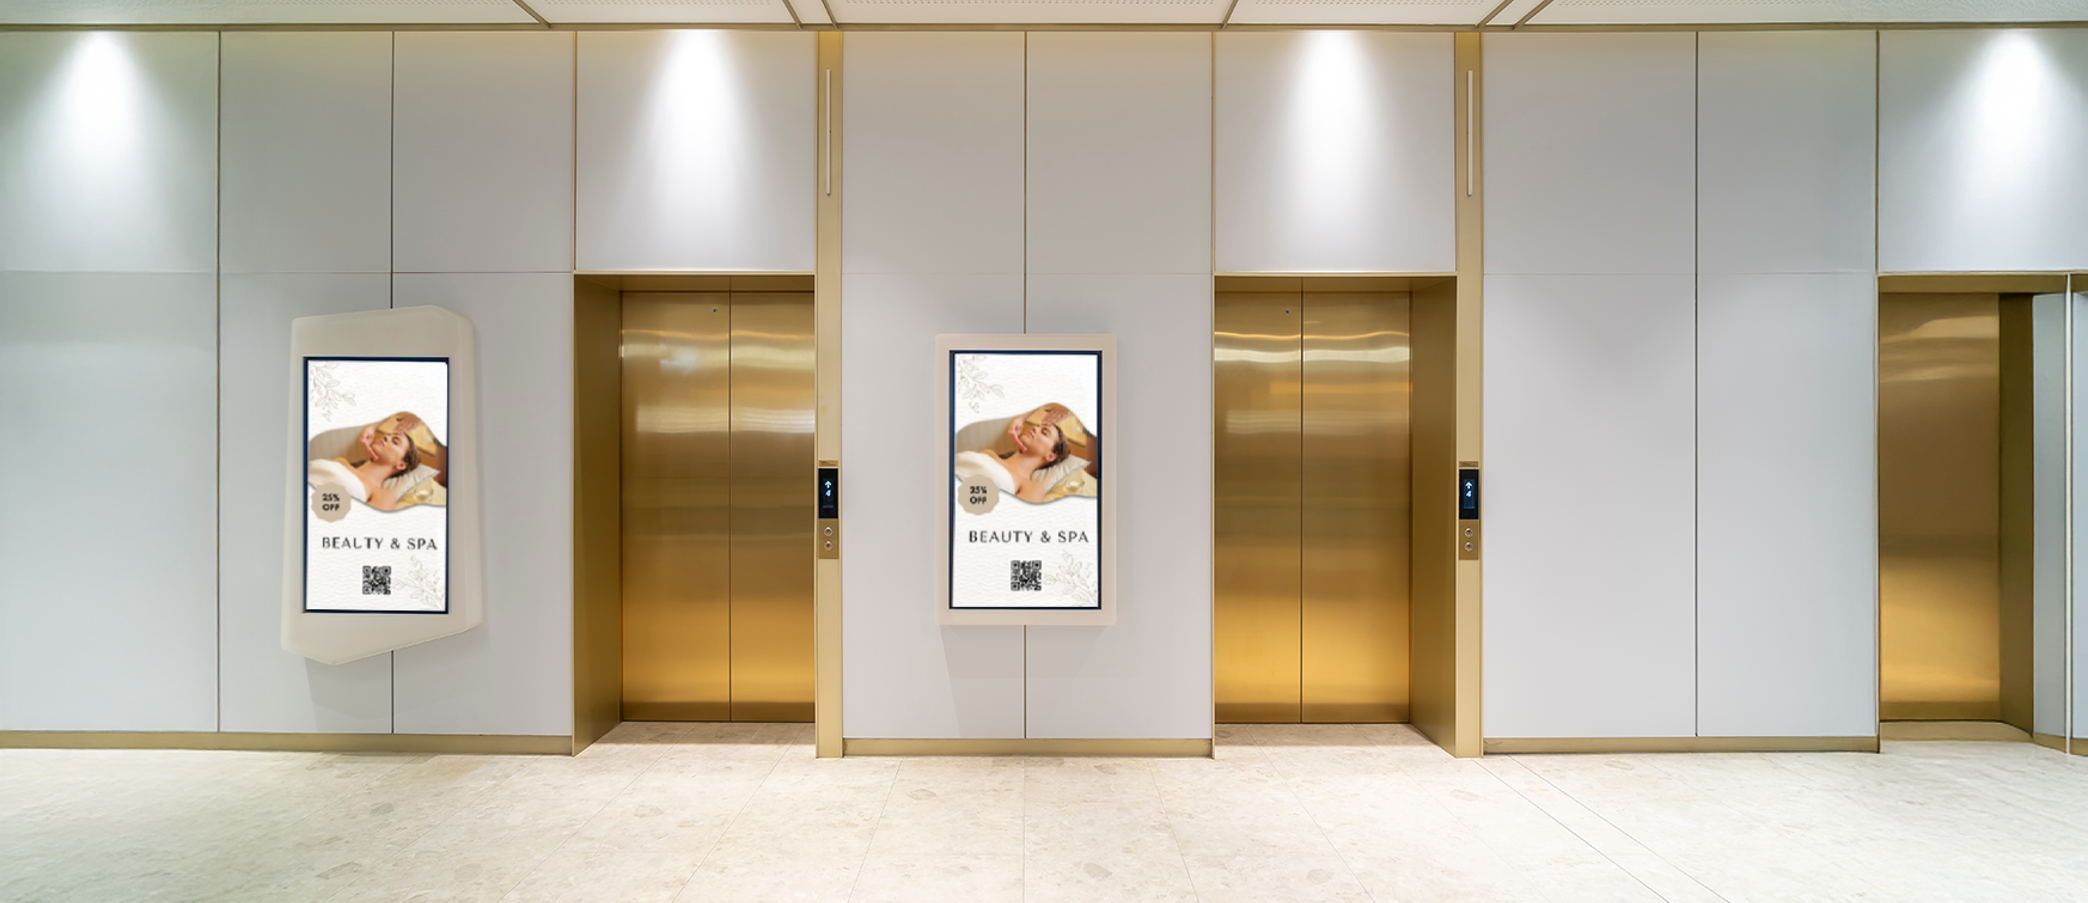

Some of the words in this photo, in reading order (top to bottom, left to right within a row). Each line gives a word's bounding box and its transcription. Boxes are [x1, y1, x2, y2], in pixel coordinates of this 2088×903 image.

[969, 486, 987, 494] 25%
[322, 493, 340, 502] 25%
[969, 496, 987, 505] OFF
[322, 503, 340, 511] OFF
[968, 530, 1033, 543] BEAUTY
[1040, 530, 1052, 543] &
[1057, 530, 1090, 543] SPA
[390, 537, 401, 550] &
[406, 537, 438, 550] SPA
